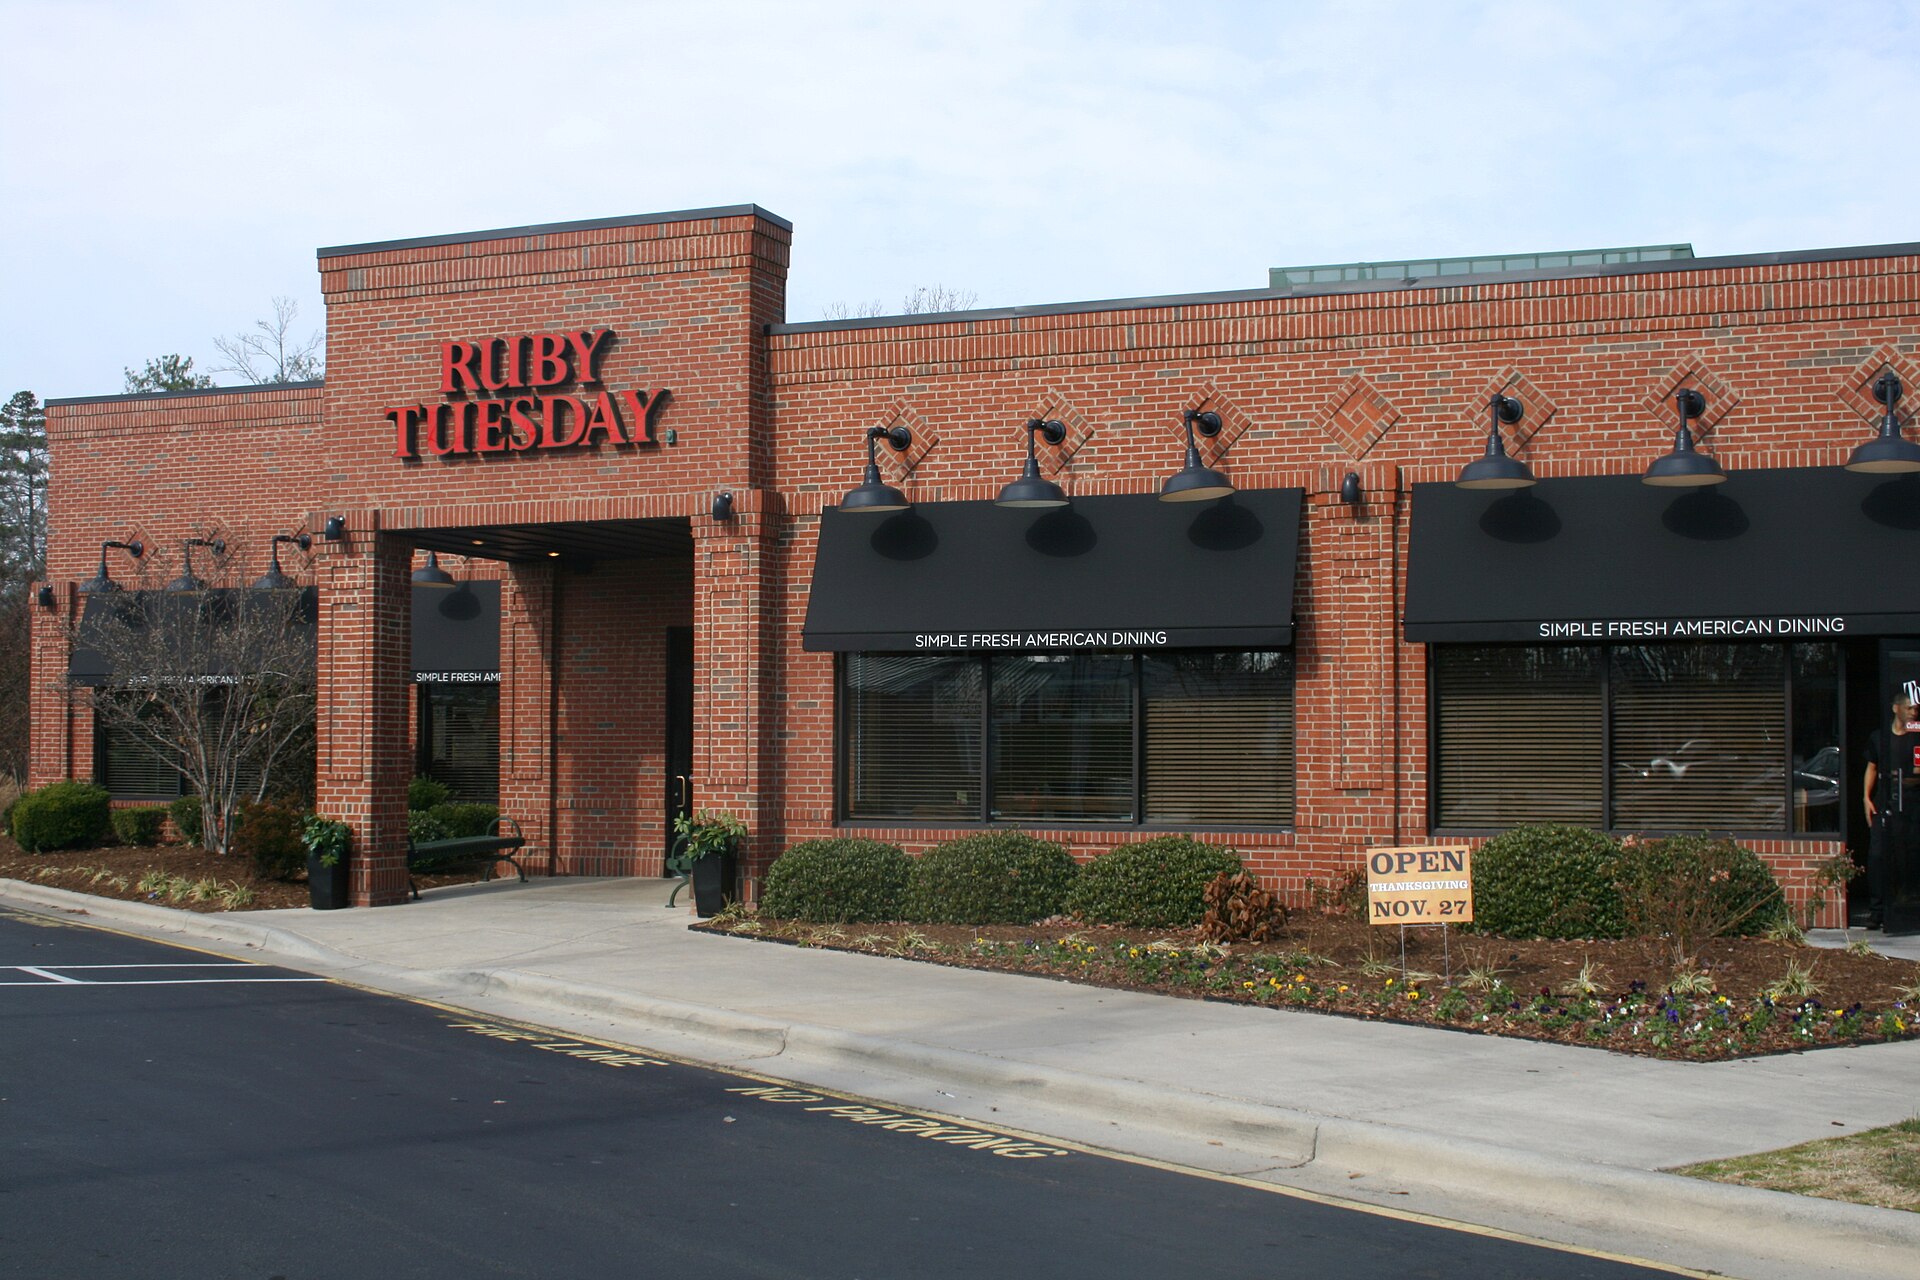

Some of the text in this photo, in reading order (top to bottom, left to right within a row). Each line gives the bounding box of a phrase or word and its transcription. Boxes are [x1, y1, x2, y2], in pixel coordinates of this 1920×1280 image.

[439, 329, 611, 393] RUBY
[384, 388, 667, 458] TUESDAY
[1539, 617, 1844, 637] SIMPLE FRESH AMERICAN DINING
[915, 631, 1167, 648] SIMPLE FRESH AMERICAN DINING
[416, 672, 449, 682] SIMPLE
[451, 672, 482, 682] FRESH
[1371, 850, 1465, 875] OPEN
[1370, 880, 1468, 892] THANKSGIVING
[1374, 900, 1467, 917] NOV. 27
[531, 1043, 670, 1067] LANE
[724, 1086, 1069, 1158] NO PARKING
